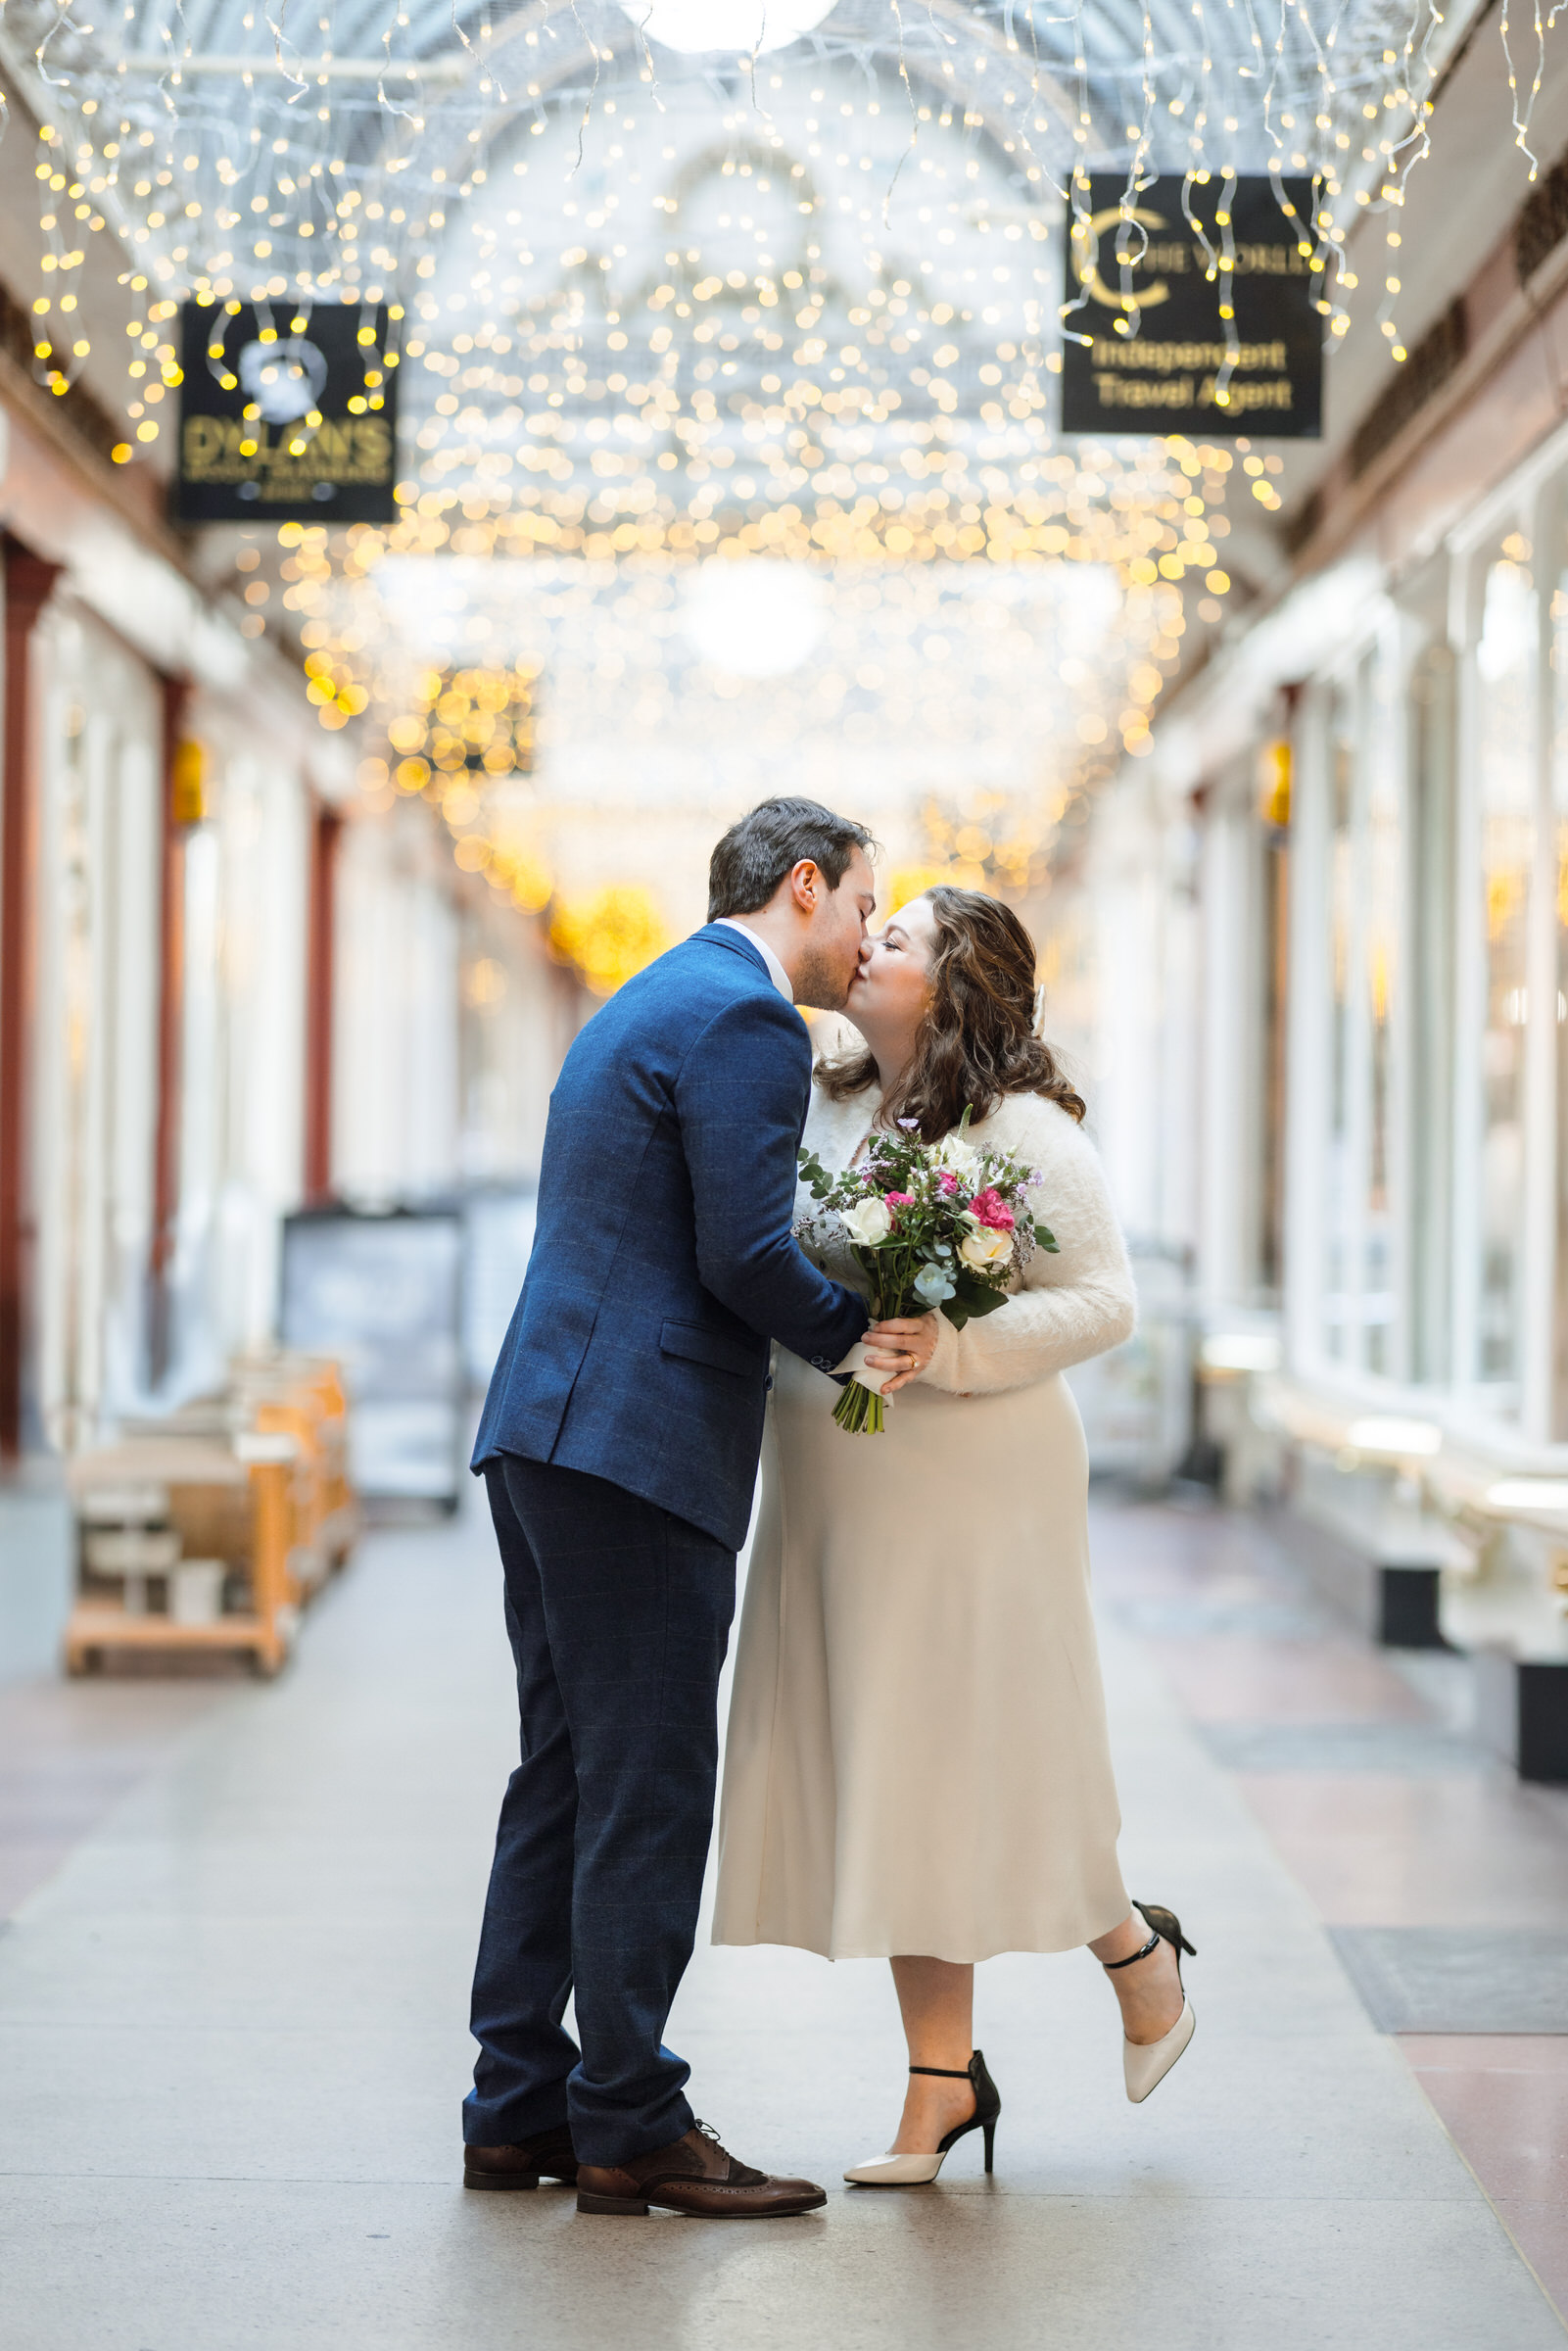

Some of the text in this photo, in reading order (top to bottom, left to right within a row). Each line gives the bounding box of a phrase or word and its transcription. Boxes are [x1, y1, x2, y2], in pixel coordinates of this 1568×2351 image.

[1071, 207, 1168, 309] C
[1092, 373, 1294, 416] Travel Agent
